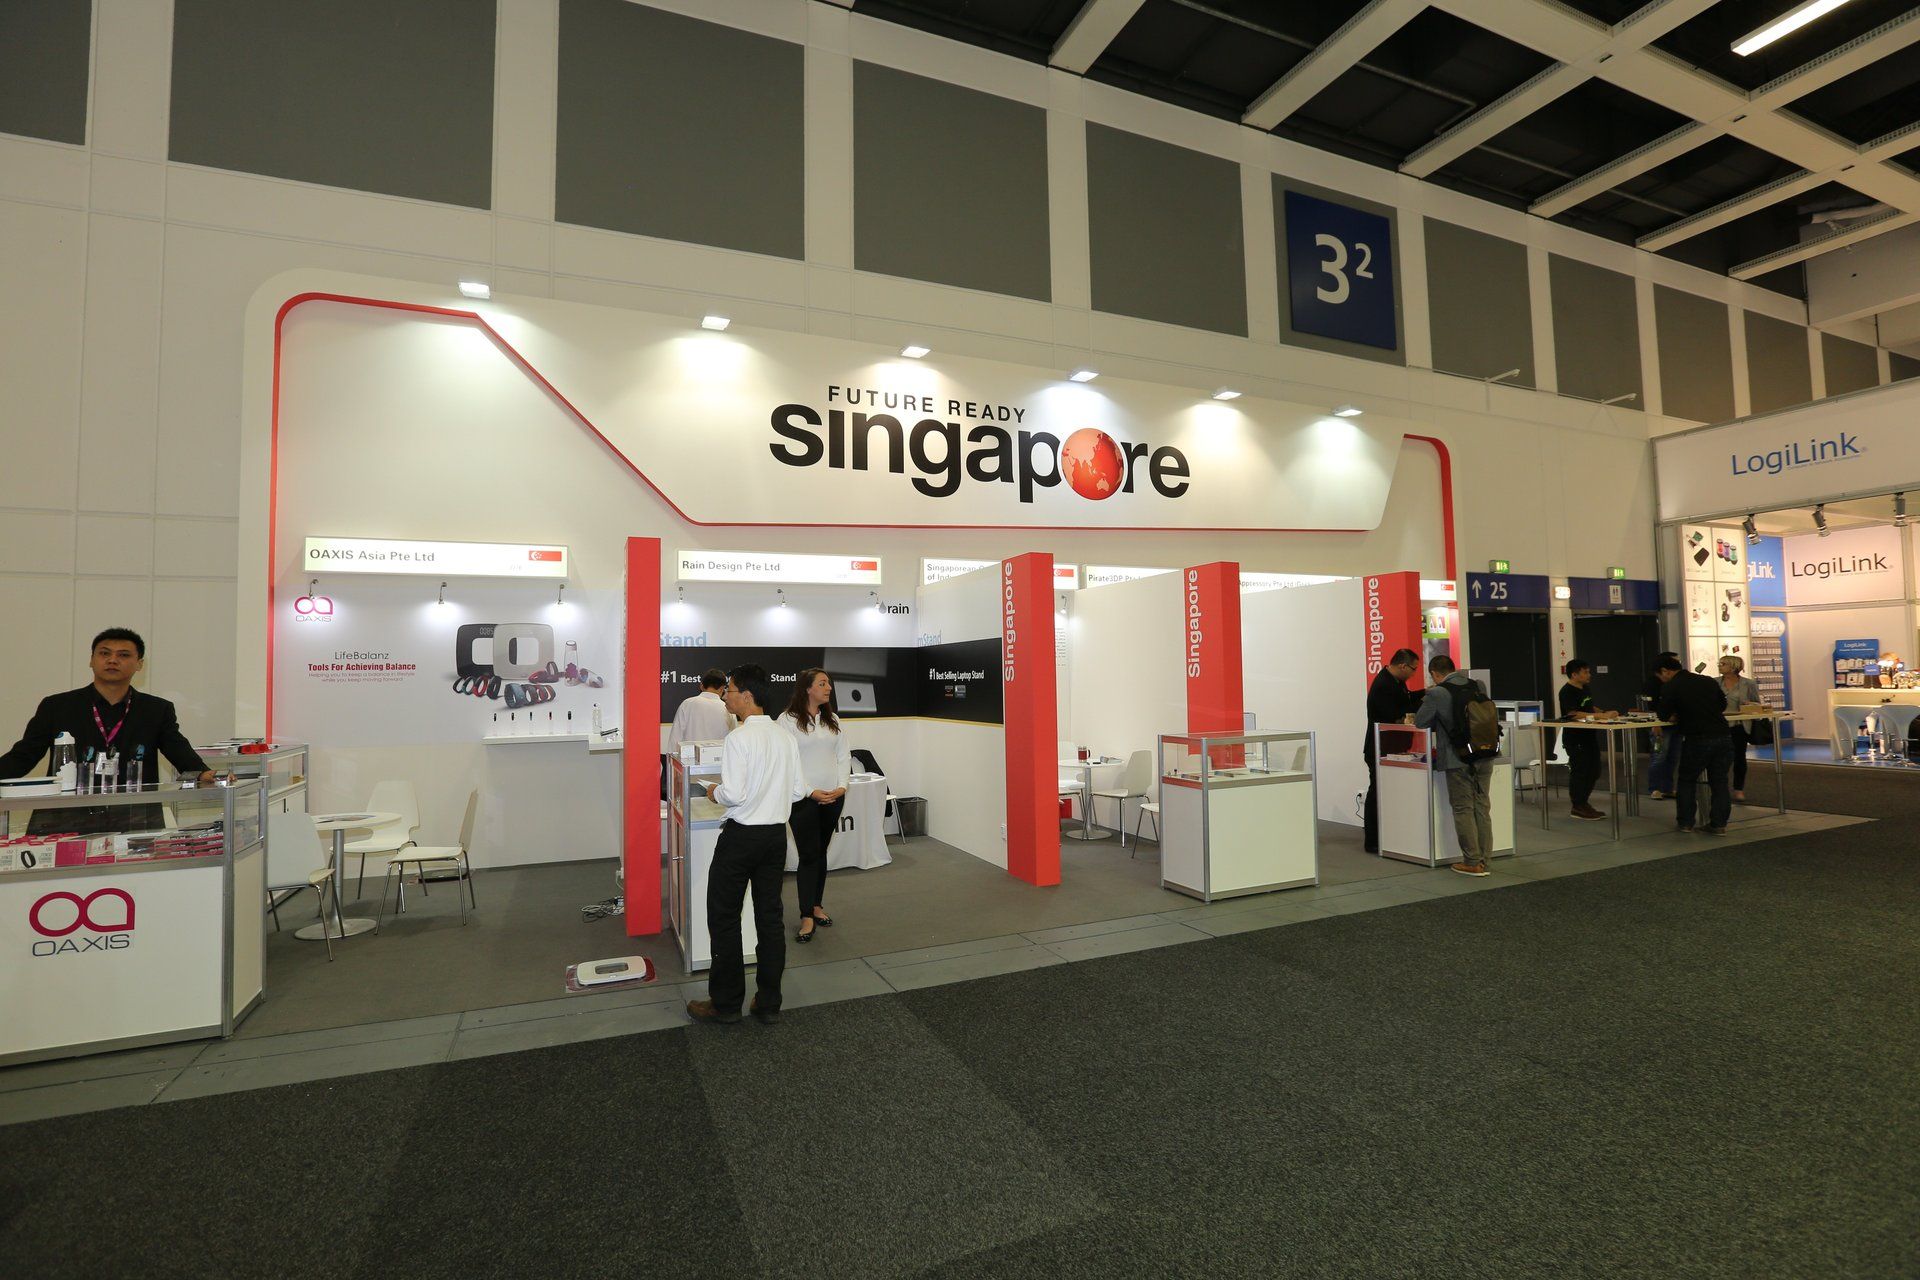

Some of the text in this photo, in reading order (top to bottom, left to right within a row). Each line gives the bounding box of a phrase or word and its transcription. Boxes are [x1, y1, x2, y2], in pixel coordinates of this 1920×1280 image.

[828, 385, 1027, 423] FUTURE READY
[1732, 432, 1860, 475] LogiLink
[310, 549, 435, 562] OAXIS Asia Pte Ltd
[682, 560, 780, 573] Rain Design Pte Ltd
[1791, 553, 1888, 579] LogiLink
[1490, 581, 1508, 599] 25
[887, 603, 910, 615] rain
[1004, 562, 1016, 682] Singapore
[1188, 570, 1202, 678] Singapore
[1368, 577, 1384, 674] Singapore
[334, 651, 390, 660] LifeBalanz
[308, 662, 416, 671] Tools For Achieving Balance
[929, 668, 935, 680] #1
[936, 671, 944, 680] Best
[957, 670, 971, 681] Laptop
[972, 669, 984, 680] Stand
[661, 670, 797, 683] #1 Best Stand
[33, 934, 130, 957] OAXIS
